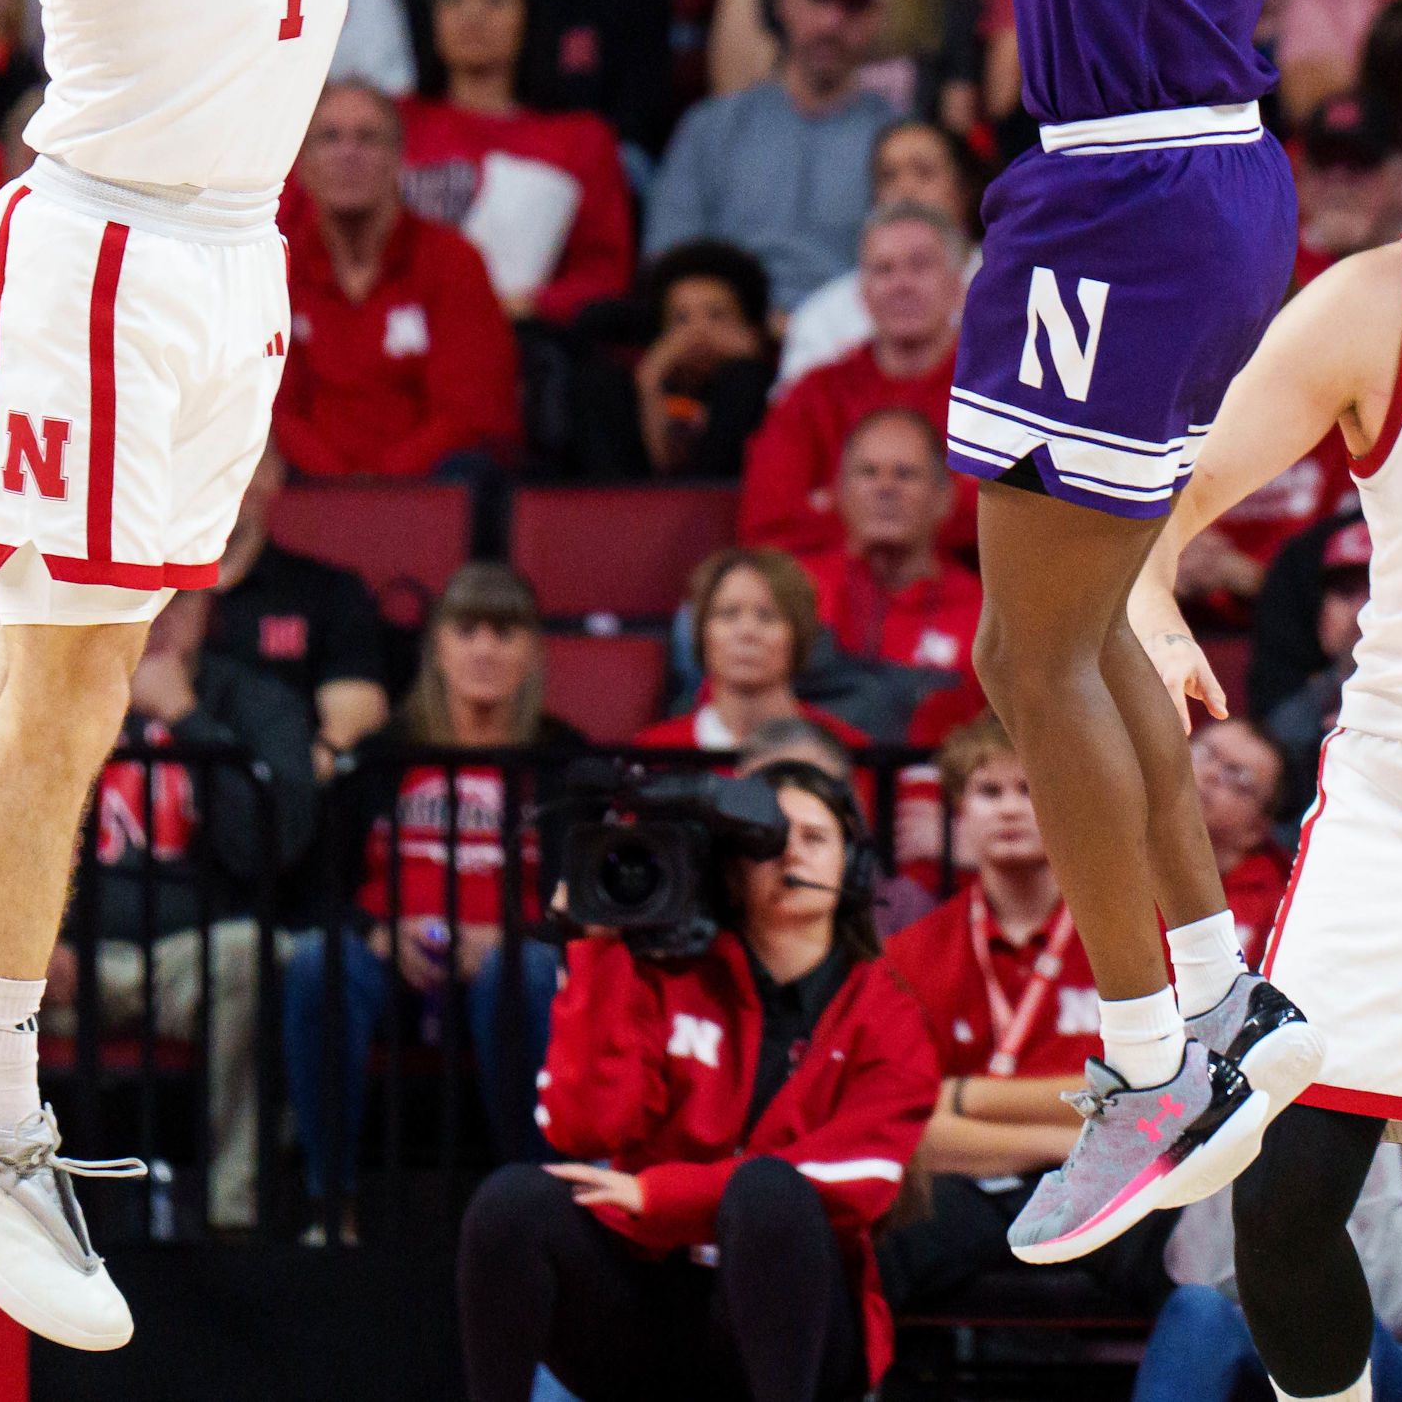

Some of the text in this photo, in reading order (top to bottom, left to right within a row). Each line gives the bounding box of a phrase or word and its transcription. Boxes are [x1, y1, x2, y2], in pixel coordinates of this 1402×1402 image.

[1018, 266, 1110, 402] N
[1, 409, 72, 502] N
[667, 1013, 723, 1068] N
